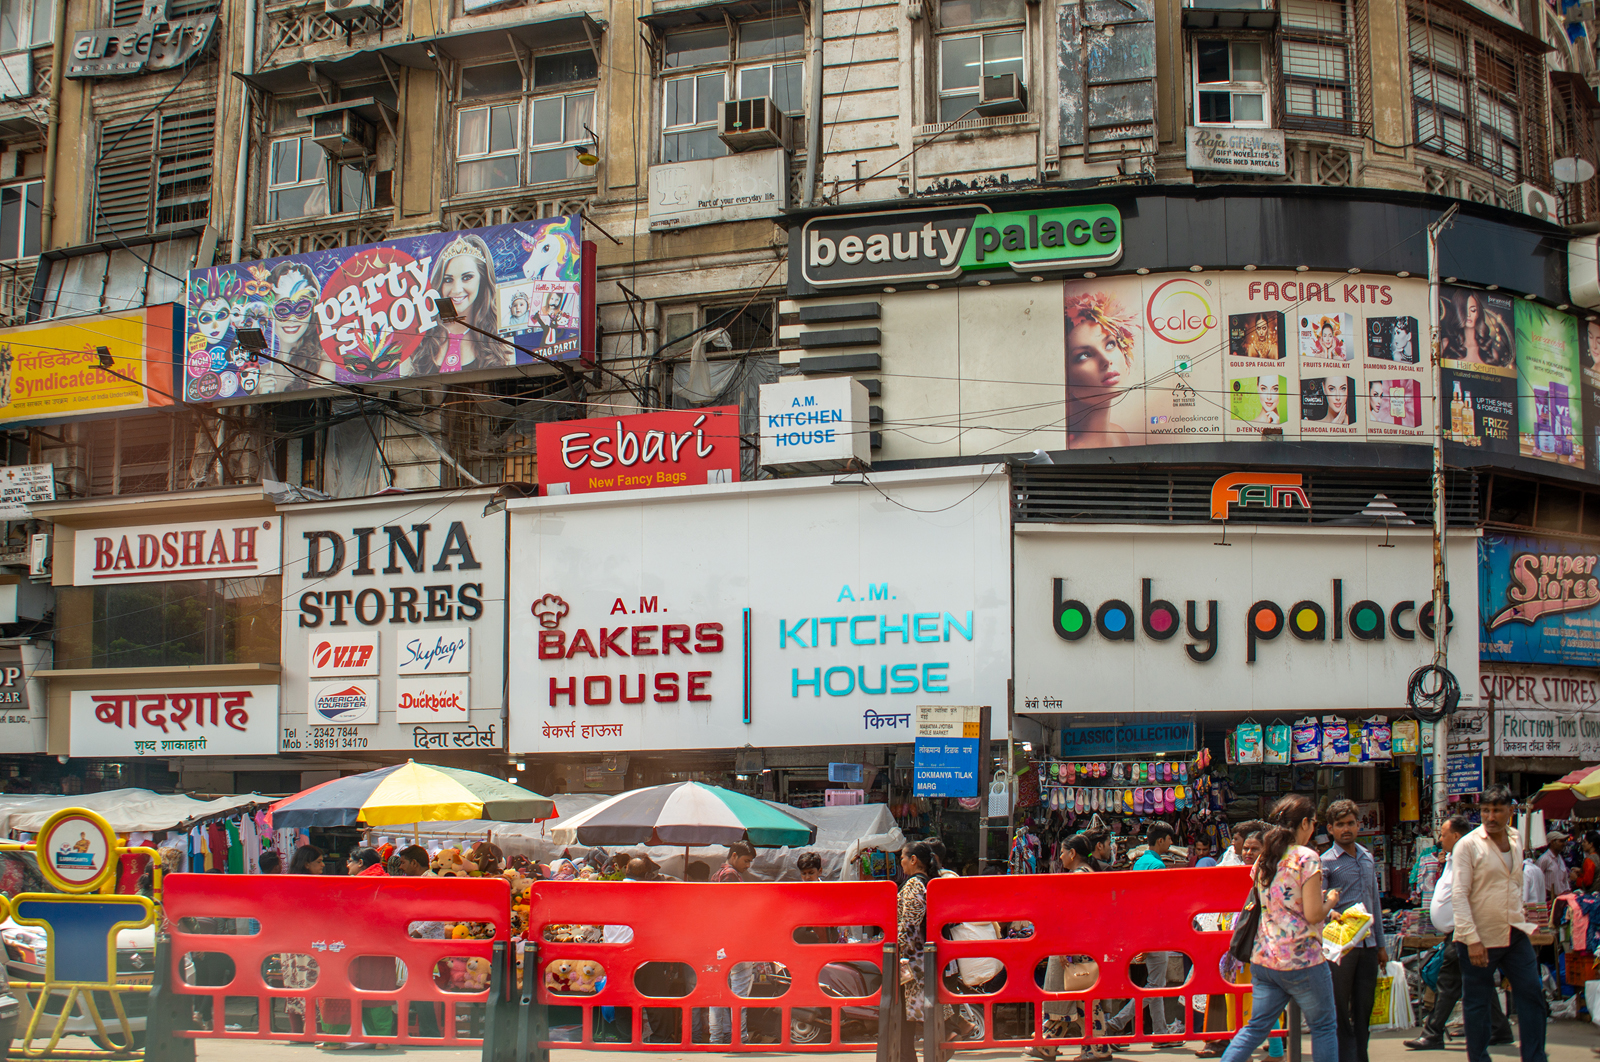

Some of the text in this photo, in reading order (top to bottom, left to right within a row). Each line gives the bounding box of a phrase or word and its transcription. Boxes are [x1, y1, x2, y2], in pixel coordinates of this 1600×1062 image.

[720, 198, 734, 207] your
[736, 194, 762, 203] everyday
[765, 193, 775, 201] life
[810, 215, 1117, 266] beauty palace
[536, 282, 565, 291] Hello Baby
[1248, 281, 1393, 305] FACIAL KITS
[314, 256, 432, 341] party
[336, 285, 442, 356] shop
[1153, 309, 1218, 331] caleo
[554, 340, 578, 354] PARTY
[191, 357, 209, 366] MOM
[1456, 361, 1497, 374] Hair Serum
[15, 363, 137, 397] SyndicateBank
[200, 384, 218, 392] Bride
[109, 390, 139, 399] Undertaking
[791, 396, 818, 408] A.M.
[1496, 400, 1513, 408] SHINE
[768, 409, 842, 428] KITCHEN
[1482, 404, 1502, 413] FORGET
[1502, 407, 1513, 415] THE
[1151, 425, 1220, 435] www.caleo.co.in
[1482, 416, 1509, 430] FRIZZ
[776, 429, 835, 447] HOUSE
[1485, 427, 1508, 440] HAIR
[30, 485, 49, 493] CLINIC
[589, 470, 687, 489] New Fancy Bags
[31, 493, 52, 501] CENTRE
[1210, 472, 1311, 520] FAM
[94, 527, 259, 572] BADSHAH
[302, 521, 481, 579] DINA
[837, 582, 897, 602] A.M.
[299, 583, 484, 628] STORES
[610, 596, 668, 616] A.M.
[779, 611, 973, 649] KITCHEN
[1052, 577, 1455, 664] baby palace
[538, 622, 724, 660] BAKERS
[399, 636, 467, 670] Skybags
[549, 671, 713, 707] HOUSE
[792, 662, 950, 698] HOUSE
[1480, 675, 1597, 704] SUPER STORES
[1042, 696, 1063, 709] पैलेस
[91, 691, 254, 734] बादशाह
[863, 709, 911, 730] किचन
[284, 729, 297, 738] Tel
[314, 728, 336, 738] 2342
[337, 727, 358, 737] 7844
[542, 721, 623, 739] बेकर्स हाऊस
[1064, 729, 1114, 746] CLASSIC
[1116, 725, 1191, 743] COLLECTION
[1503, 715, 1554, 738] FRICTION
[1556, 716, 1577, 738] TOYS
[161, 736, 208, 752] शाकाहारी
[283, 738, 301, 749] Mob
[314, 739, 341, 749] 98191
[342, 737, 368, 748] 34170
[413, 724, 495, 749] दिना स्टोर्स
[917, 771, 973, 779] LOKMANYA TILAK
[917, 782, 937, 790] MARG
